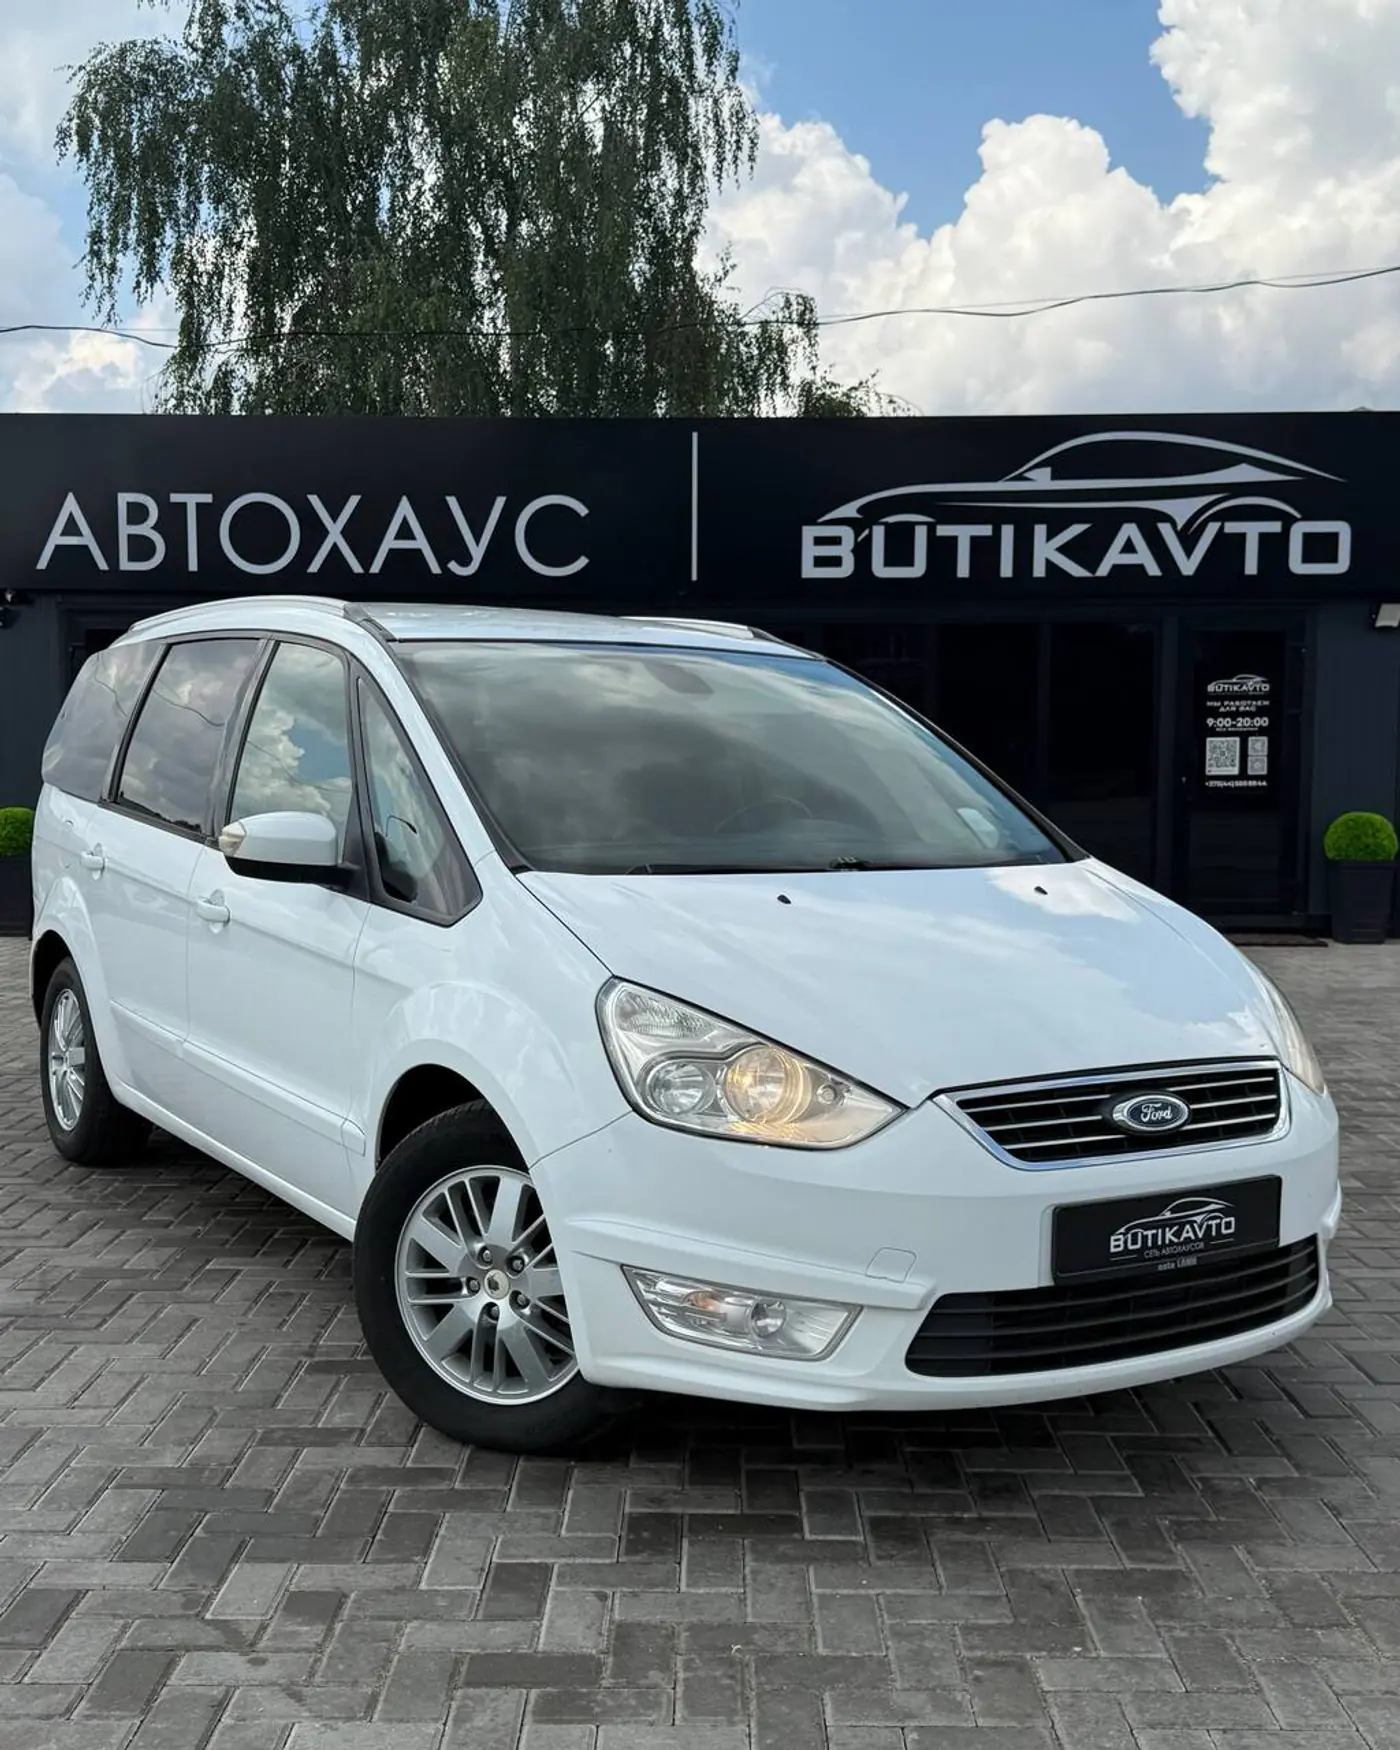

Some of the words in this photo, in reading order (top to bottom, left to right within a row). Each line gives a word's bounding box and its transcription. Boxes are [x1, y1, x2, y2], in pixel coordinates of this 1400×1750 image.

[36, 492, 590, 577] АВТОХАУС
[801, 520, 1352, 579] BUTIKAVTO
[1140, 1103, 1173, 1122] Ford
[1110, 1216, 1236, 1253] BUTIKAVTO
